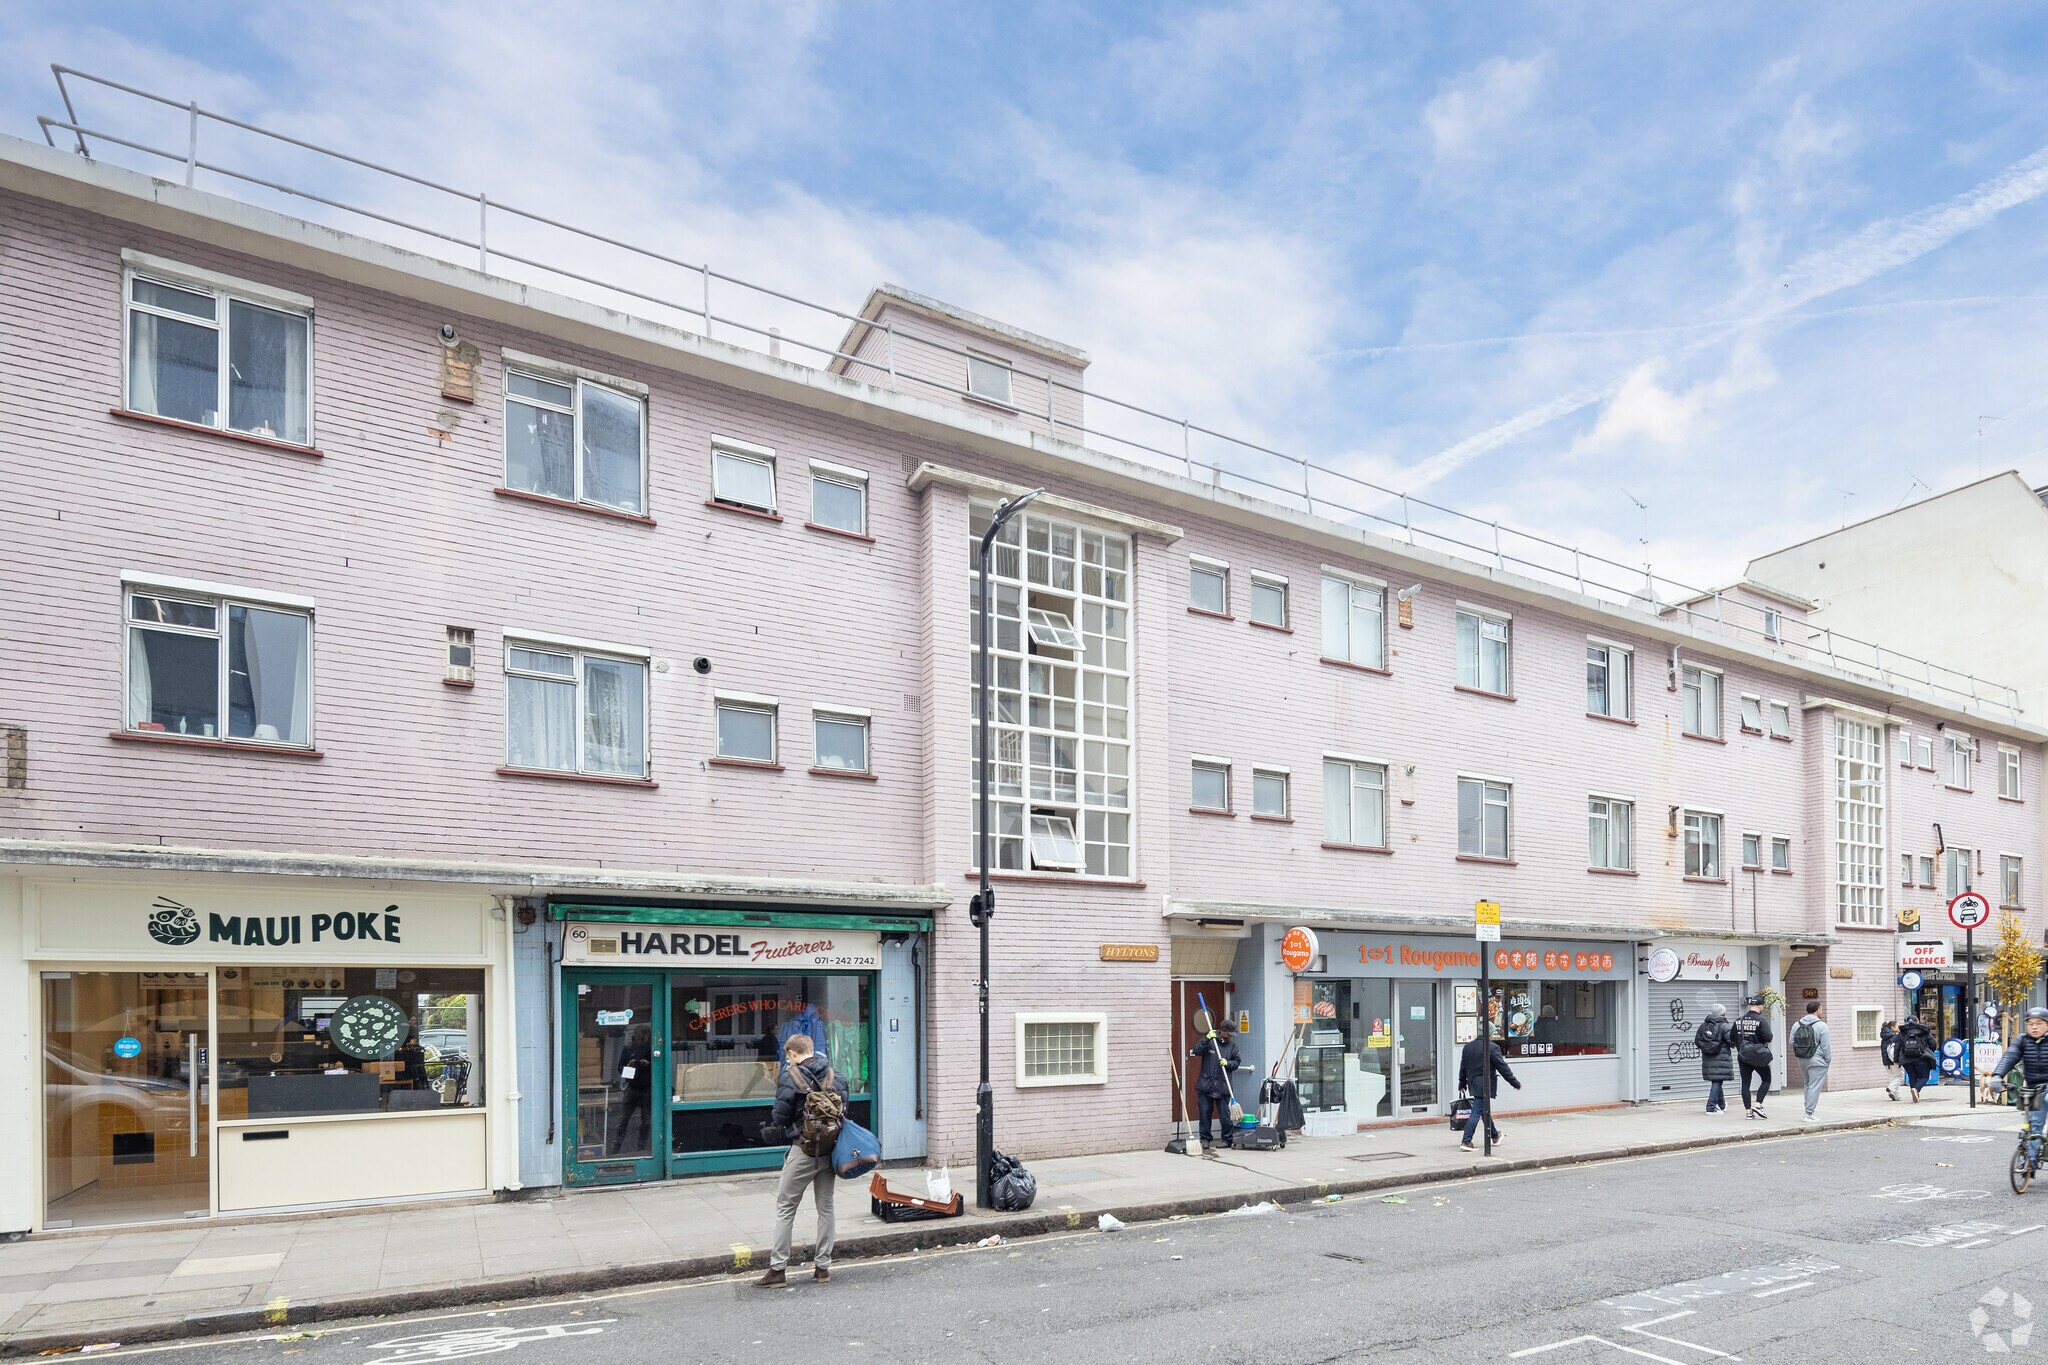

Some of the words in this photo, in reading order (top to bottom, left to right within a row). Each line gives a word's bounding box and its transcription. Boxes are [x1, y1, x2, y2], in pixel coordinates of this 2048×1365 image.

[209, 912, 300, 946] MAUI
[312, 904, 401, 943] POKÉ
[572, 931, 587, 939] 60
[621, 932, 749, 956] HARDEL
[751, 939, 834, 961] Fruiterers
[1105, 947, 1156, 957] HYLTONS
[1914, 947, 1934, 955] OFF
[1282, 948, 1309, 958] Rougamo
[1400, 945, 1481, 971] Rougamo
[854, 957, 875, 965] 7242
[1687, 953, 1713, 972] Beauty
[1715, 953, 1730, 972] Spa
[1902, 957, 1946, 965] LICENCE
[341, 1002, 359, 1016] IT'S
[748, 999, 776, 1015] WHO
[340, 1038, 361, 1053] KIND
[385, 1036, 400, 1050] DAY
[1979, 1048, 1997, 1056] OFF
